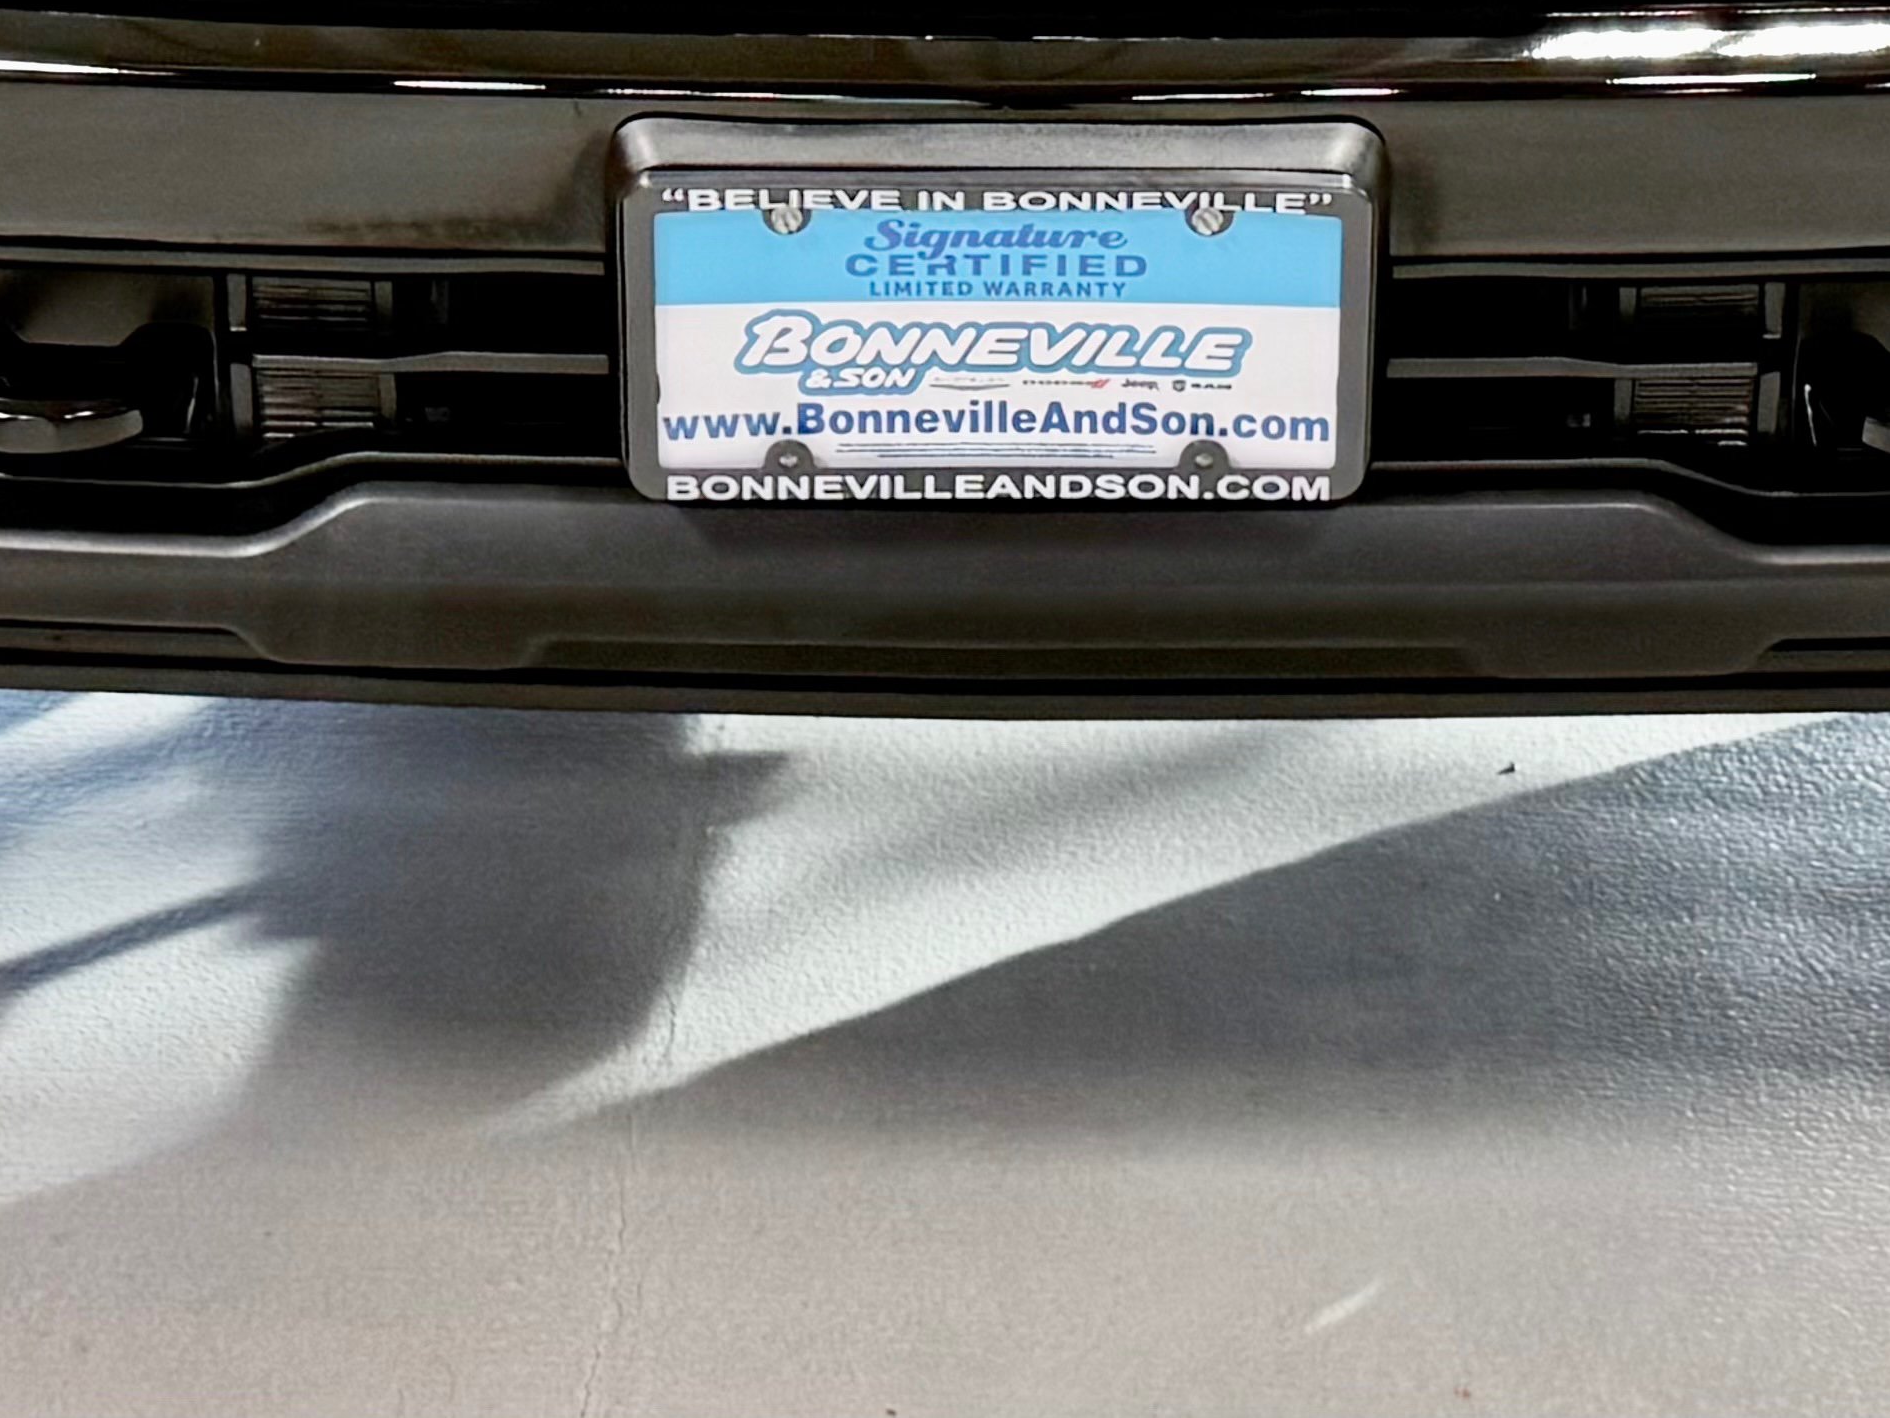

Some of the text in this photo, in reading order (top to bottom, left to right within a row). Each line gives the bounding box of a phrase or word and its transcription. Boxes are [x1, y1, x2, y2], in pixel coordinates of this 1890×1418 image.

[917, 190, 966, 211] IN
[863, 218, 1128, 261] Signature
[844, 253, 1148, 278] CERTIFIED
[868, 280, 1127, 298] LIMITED WARRANTY
[740, 315, 1244, 372] BONNEVILLE
[662, 399, 1330, 442] www.BonnevilleAndSon.com
[666, 473, 1331, 502] BONNEVILLEANDSON.COM
